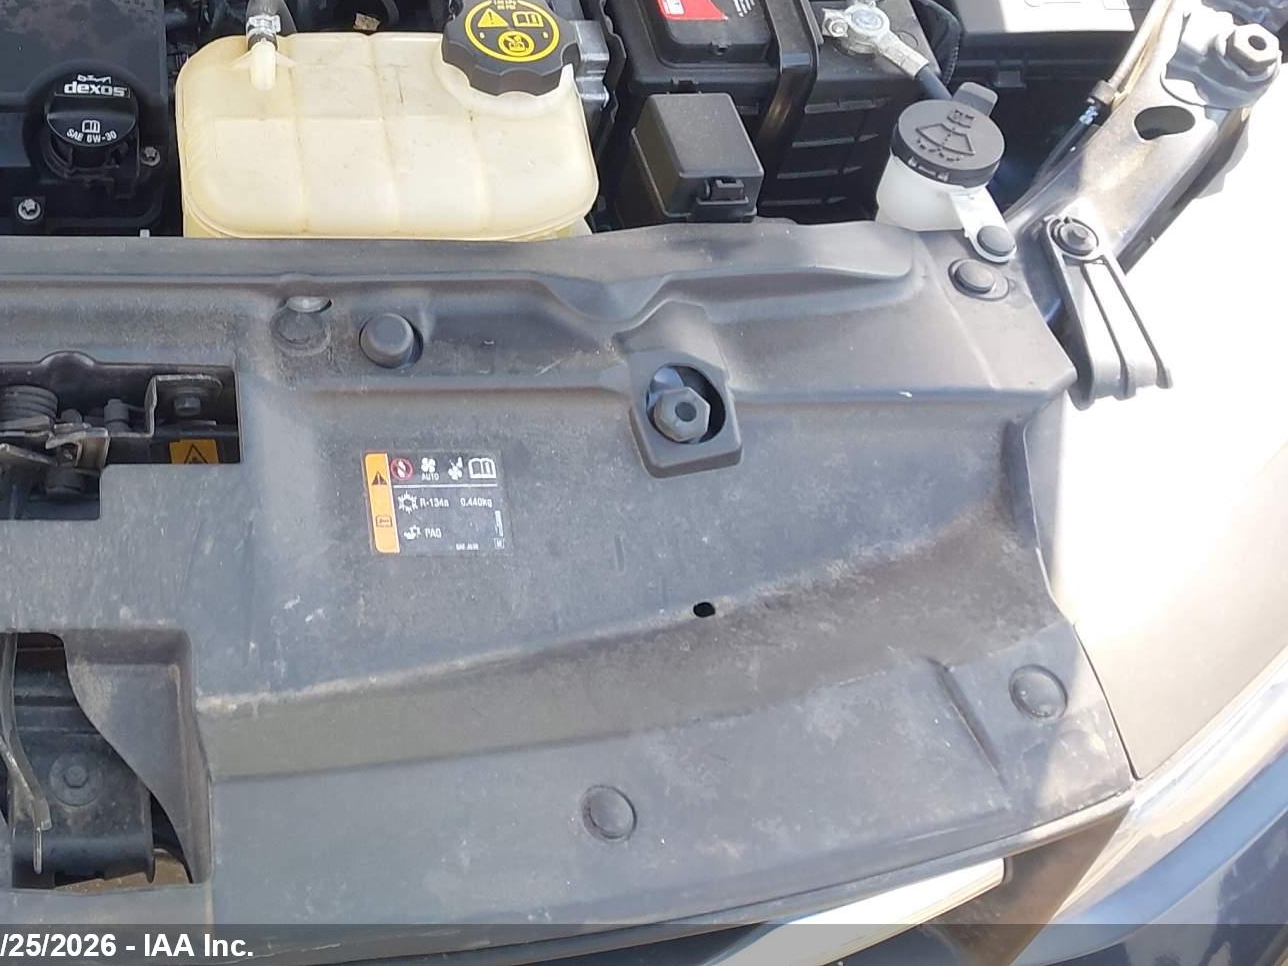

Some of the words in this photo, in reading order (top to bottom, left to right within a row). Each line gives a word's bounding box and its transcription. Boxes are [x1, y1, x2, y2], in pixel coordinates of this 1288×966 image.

[64, 81, 127, 97] dexos
[66, 128, 84, 142] SAE
[421, 472, 440, 481] AUTO
